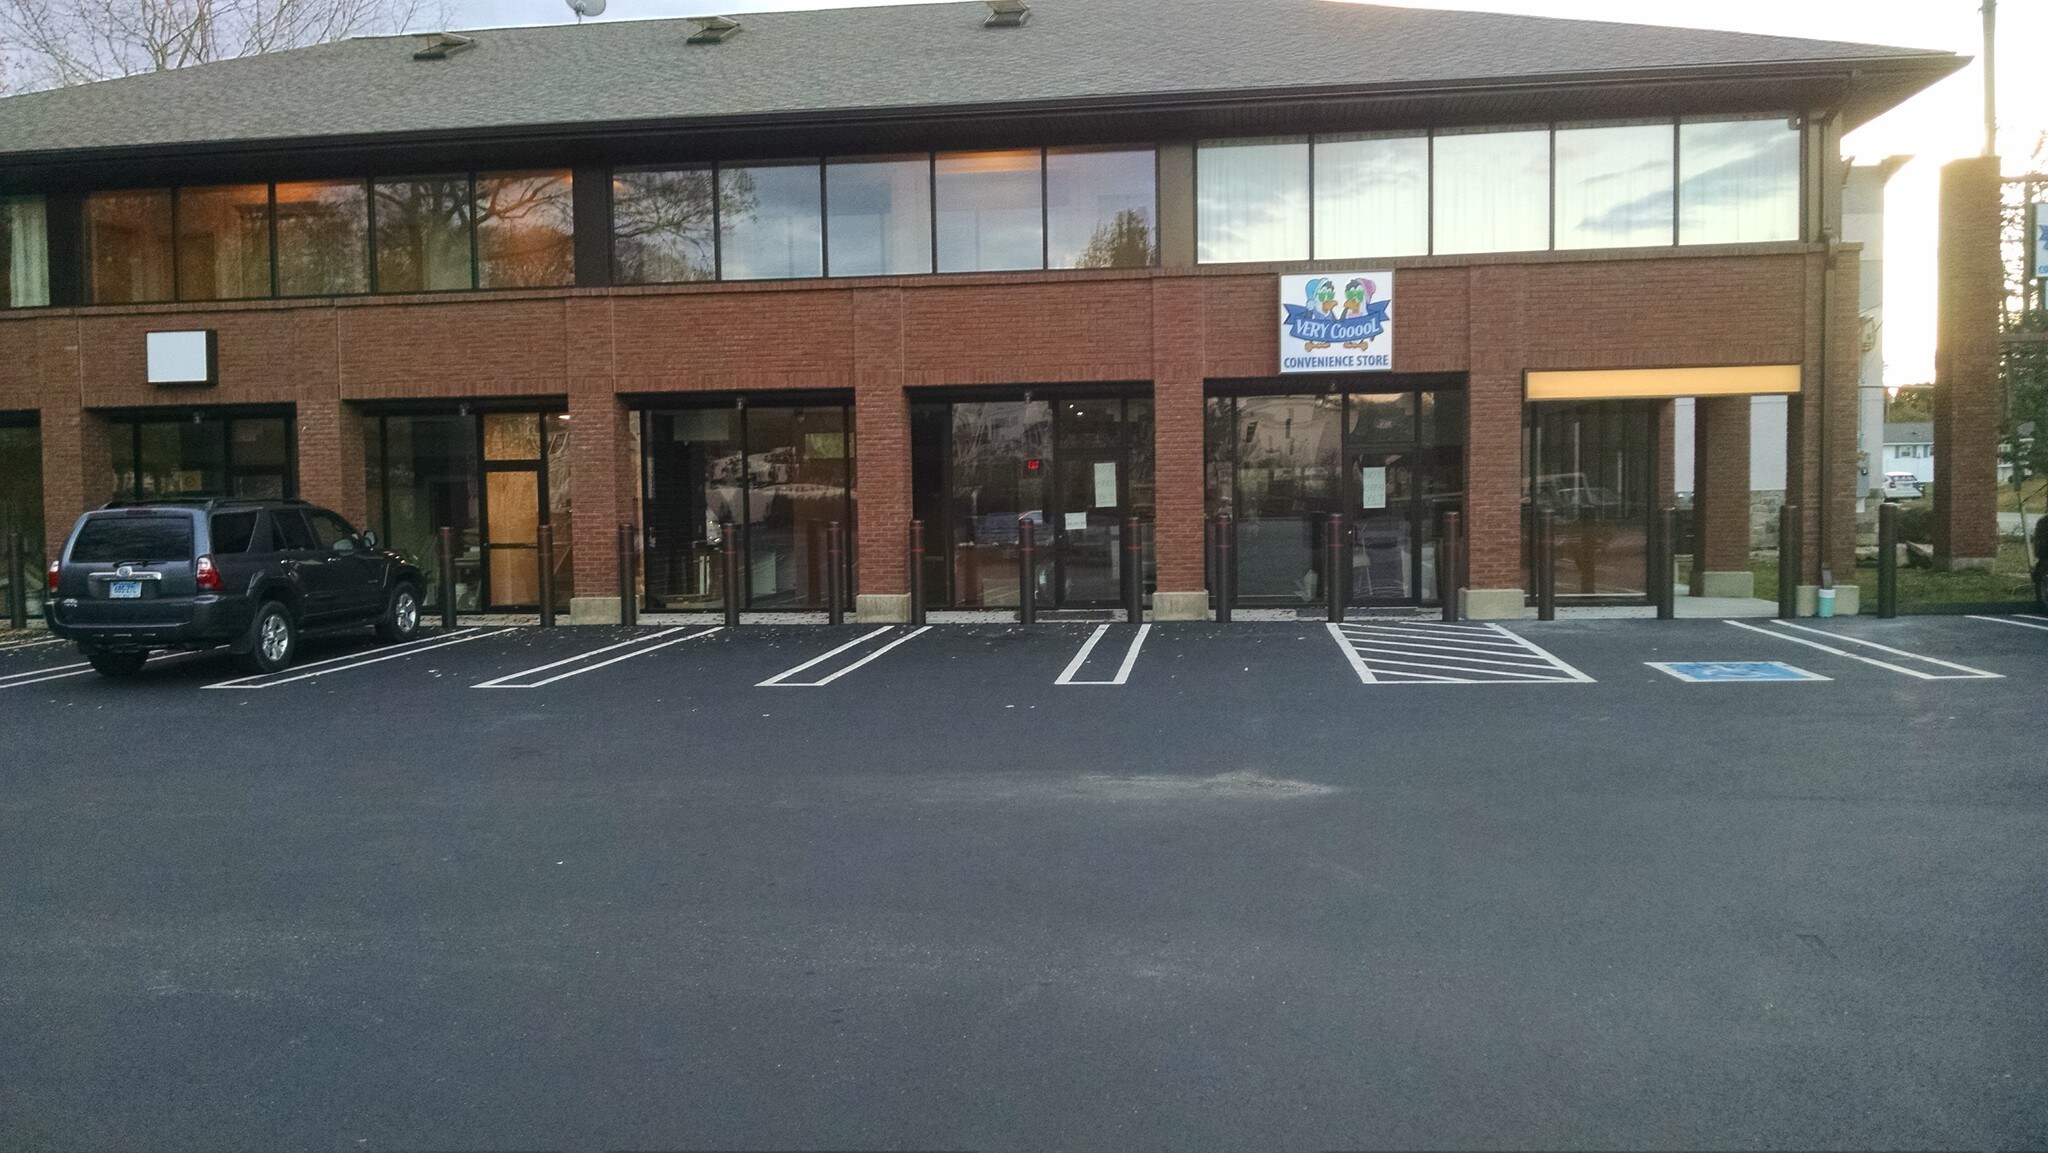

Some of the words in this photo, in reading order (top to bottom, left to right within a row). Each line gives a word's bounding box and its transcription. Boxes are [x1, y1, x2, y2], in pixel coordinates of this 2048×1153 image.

[1296, 319, 1330, 338] VERY
[1284, 355, 1354, 368] CONVENIENCE
[1356, 354, 1389, 366] STORE
